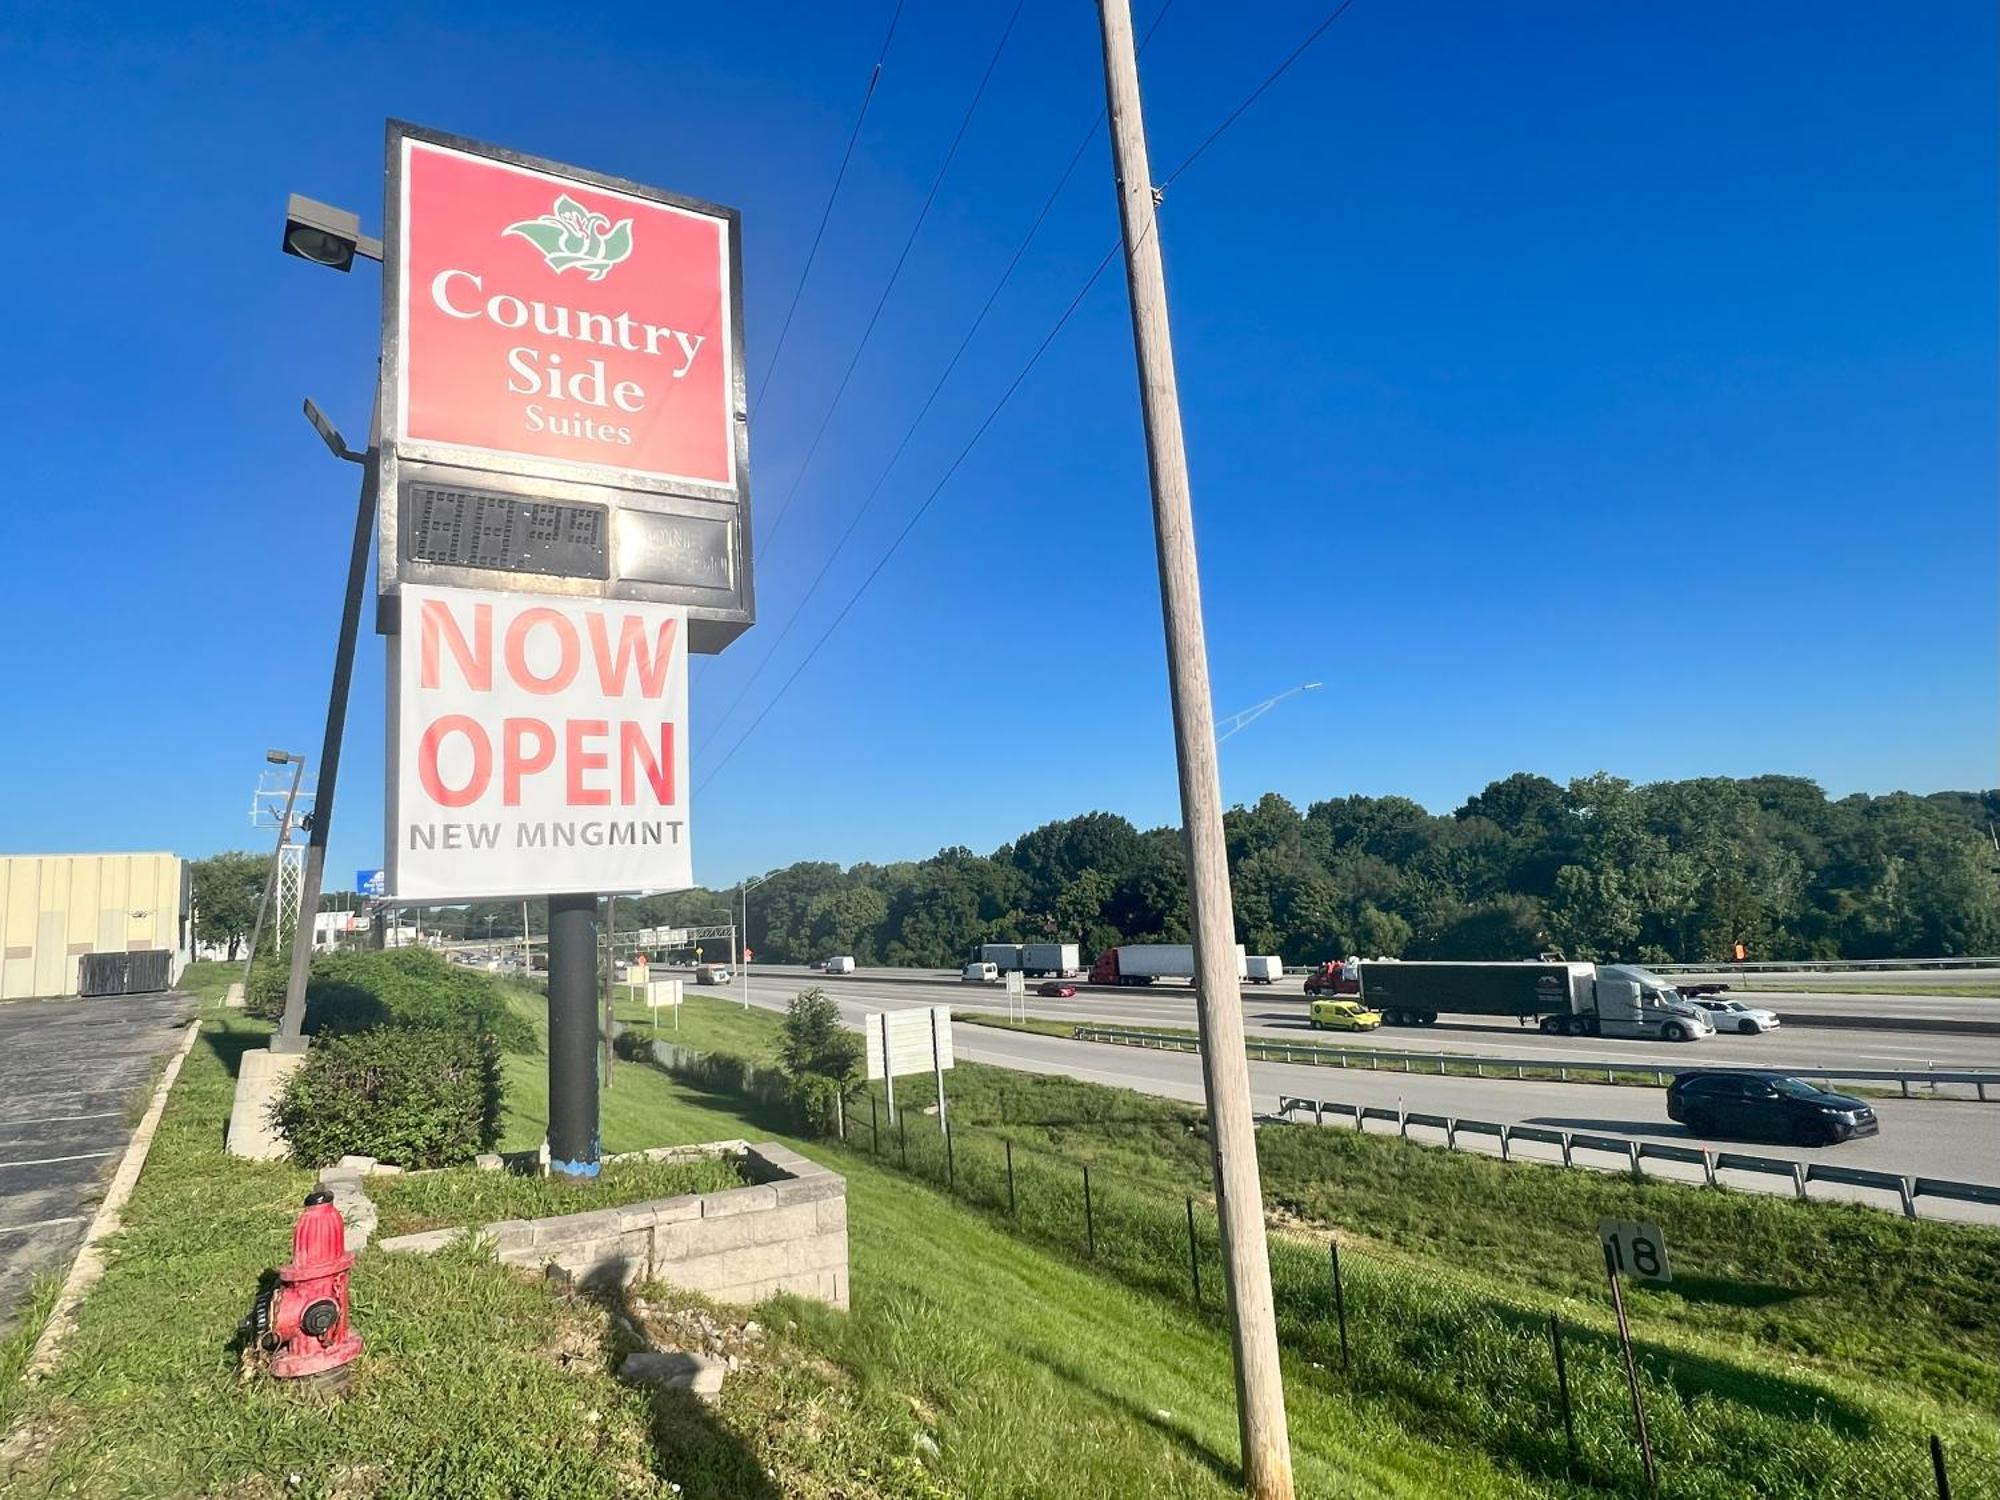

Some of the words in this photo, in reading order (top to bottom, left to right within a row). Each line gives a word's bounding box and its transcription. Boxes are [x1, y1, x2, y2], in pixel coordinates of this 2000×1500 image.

[431, 269, 705, 378] Country
[507, 346, 646, 413] Side
[525, 405, 632, 445] Suites
[420, 599, 677, 699] NOW
[418, 713, 676, 808] OPEN
[410, 822, 501, 851] NEW
[516, 821, 684, 849] MNGMNT
[1609, 1233, 1661, 1277] 18
